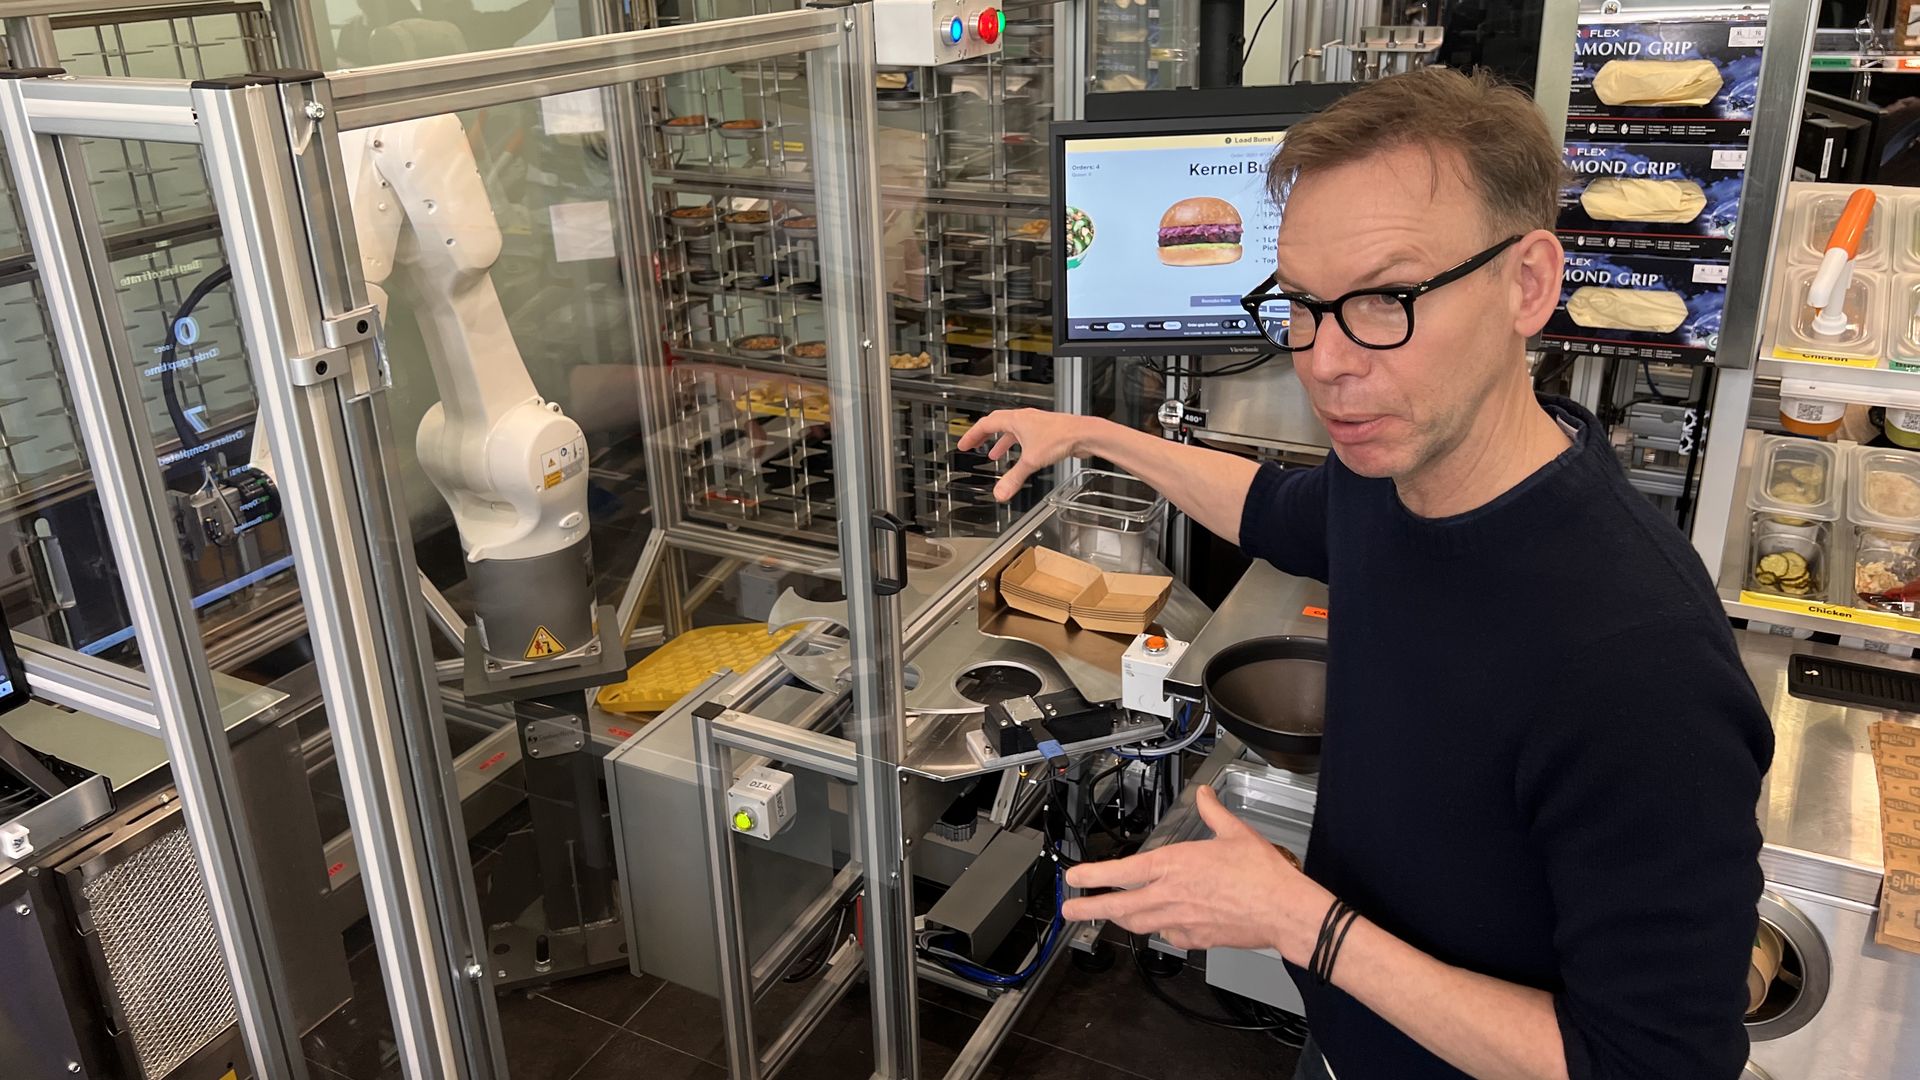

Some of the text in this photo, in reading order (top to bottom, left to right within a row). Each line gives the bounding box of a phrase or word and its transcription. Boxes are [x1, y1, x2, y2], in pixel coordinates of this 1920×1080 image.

[1648, 41, 1692, 56] GRIP
[1190, 161, 1268, 176] Kernel Bu
[1633, 162, 1677, 175] GRIP
[1617, 273, 1659, 287] GRIP
[1808, 605, 1853, 619] Chicken
[749, 780, 774, 791] DIAL
